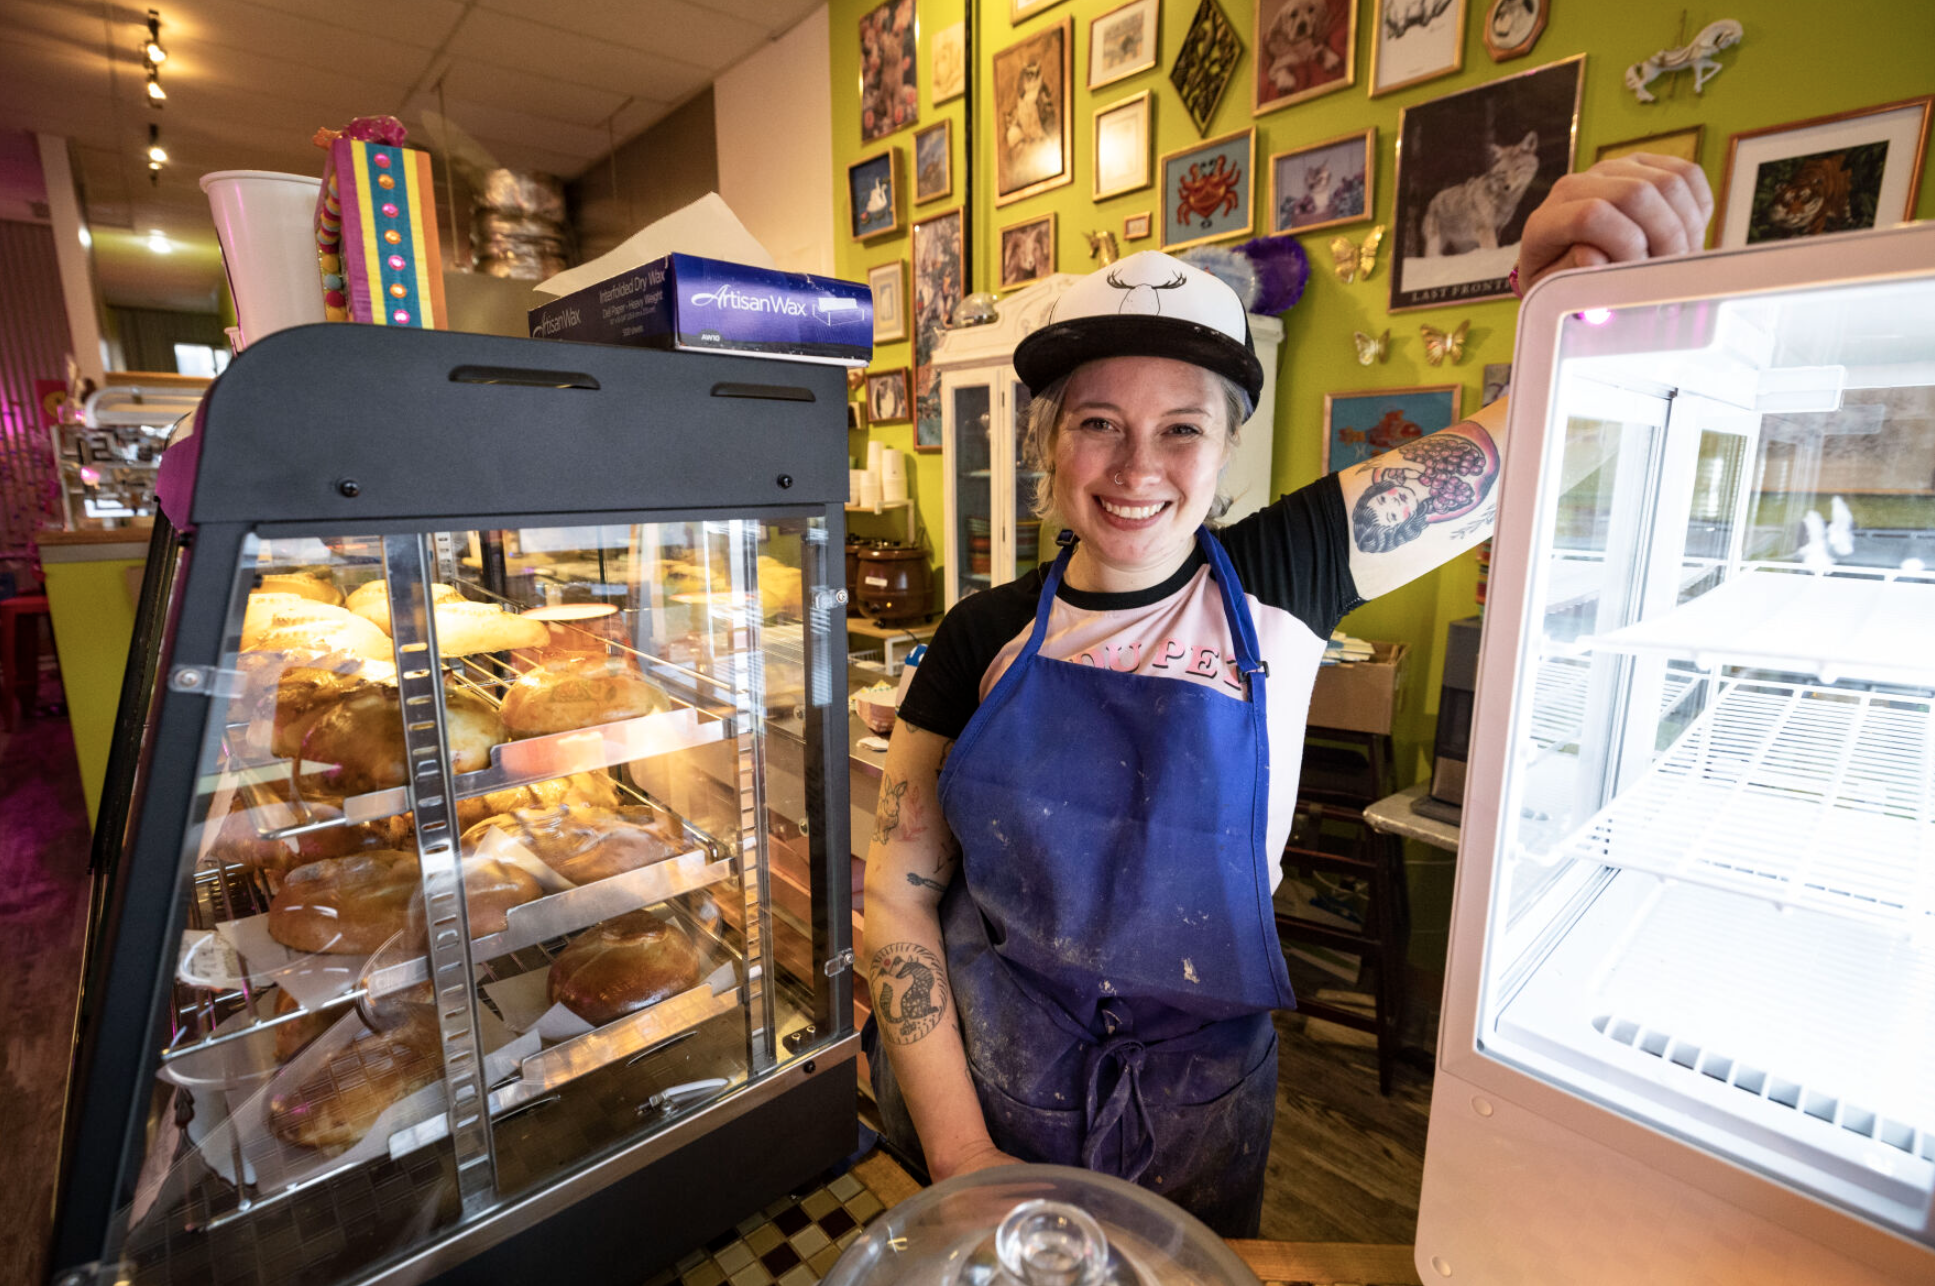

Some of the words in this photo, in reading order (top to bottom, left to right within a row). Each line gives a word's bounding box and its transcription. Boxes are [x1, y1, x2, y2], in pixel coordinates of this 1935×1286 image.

[600, 277, 634, 304] Interfolded
[634, 276, 647, 292] Dry
[648, 270, 666, 286] Wax
[691, 284, 807, 317] ArtisanWax
[1412, 289, 1446, 302] LAST
[1451, 280, 1510, 297] FRONTI
